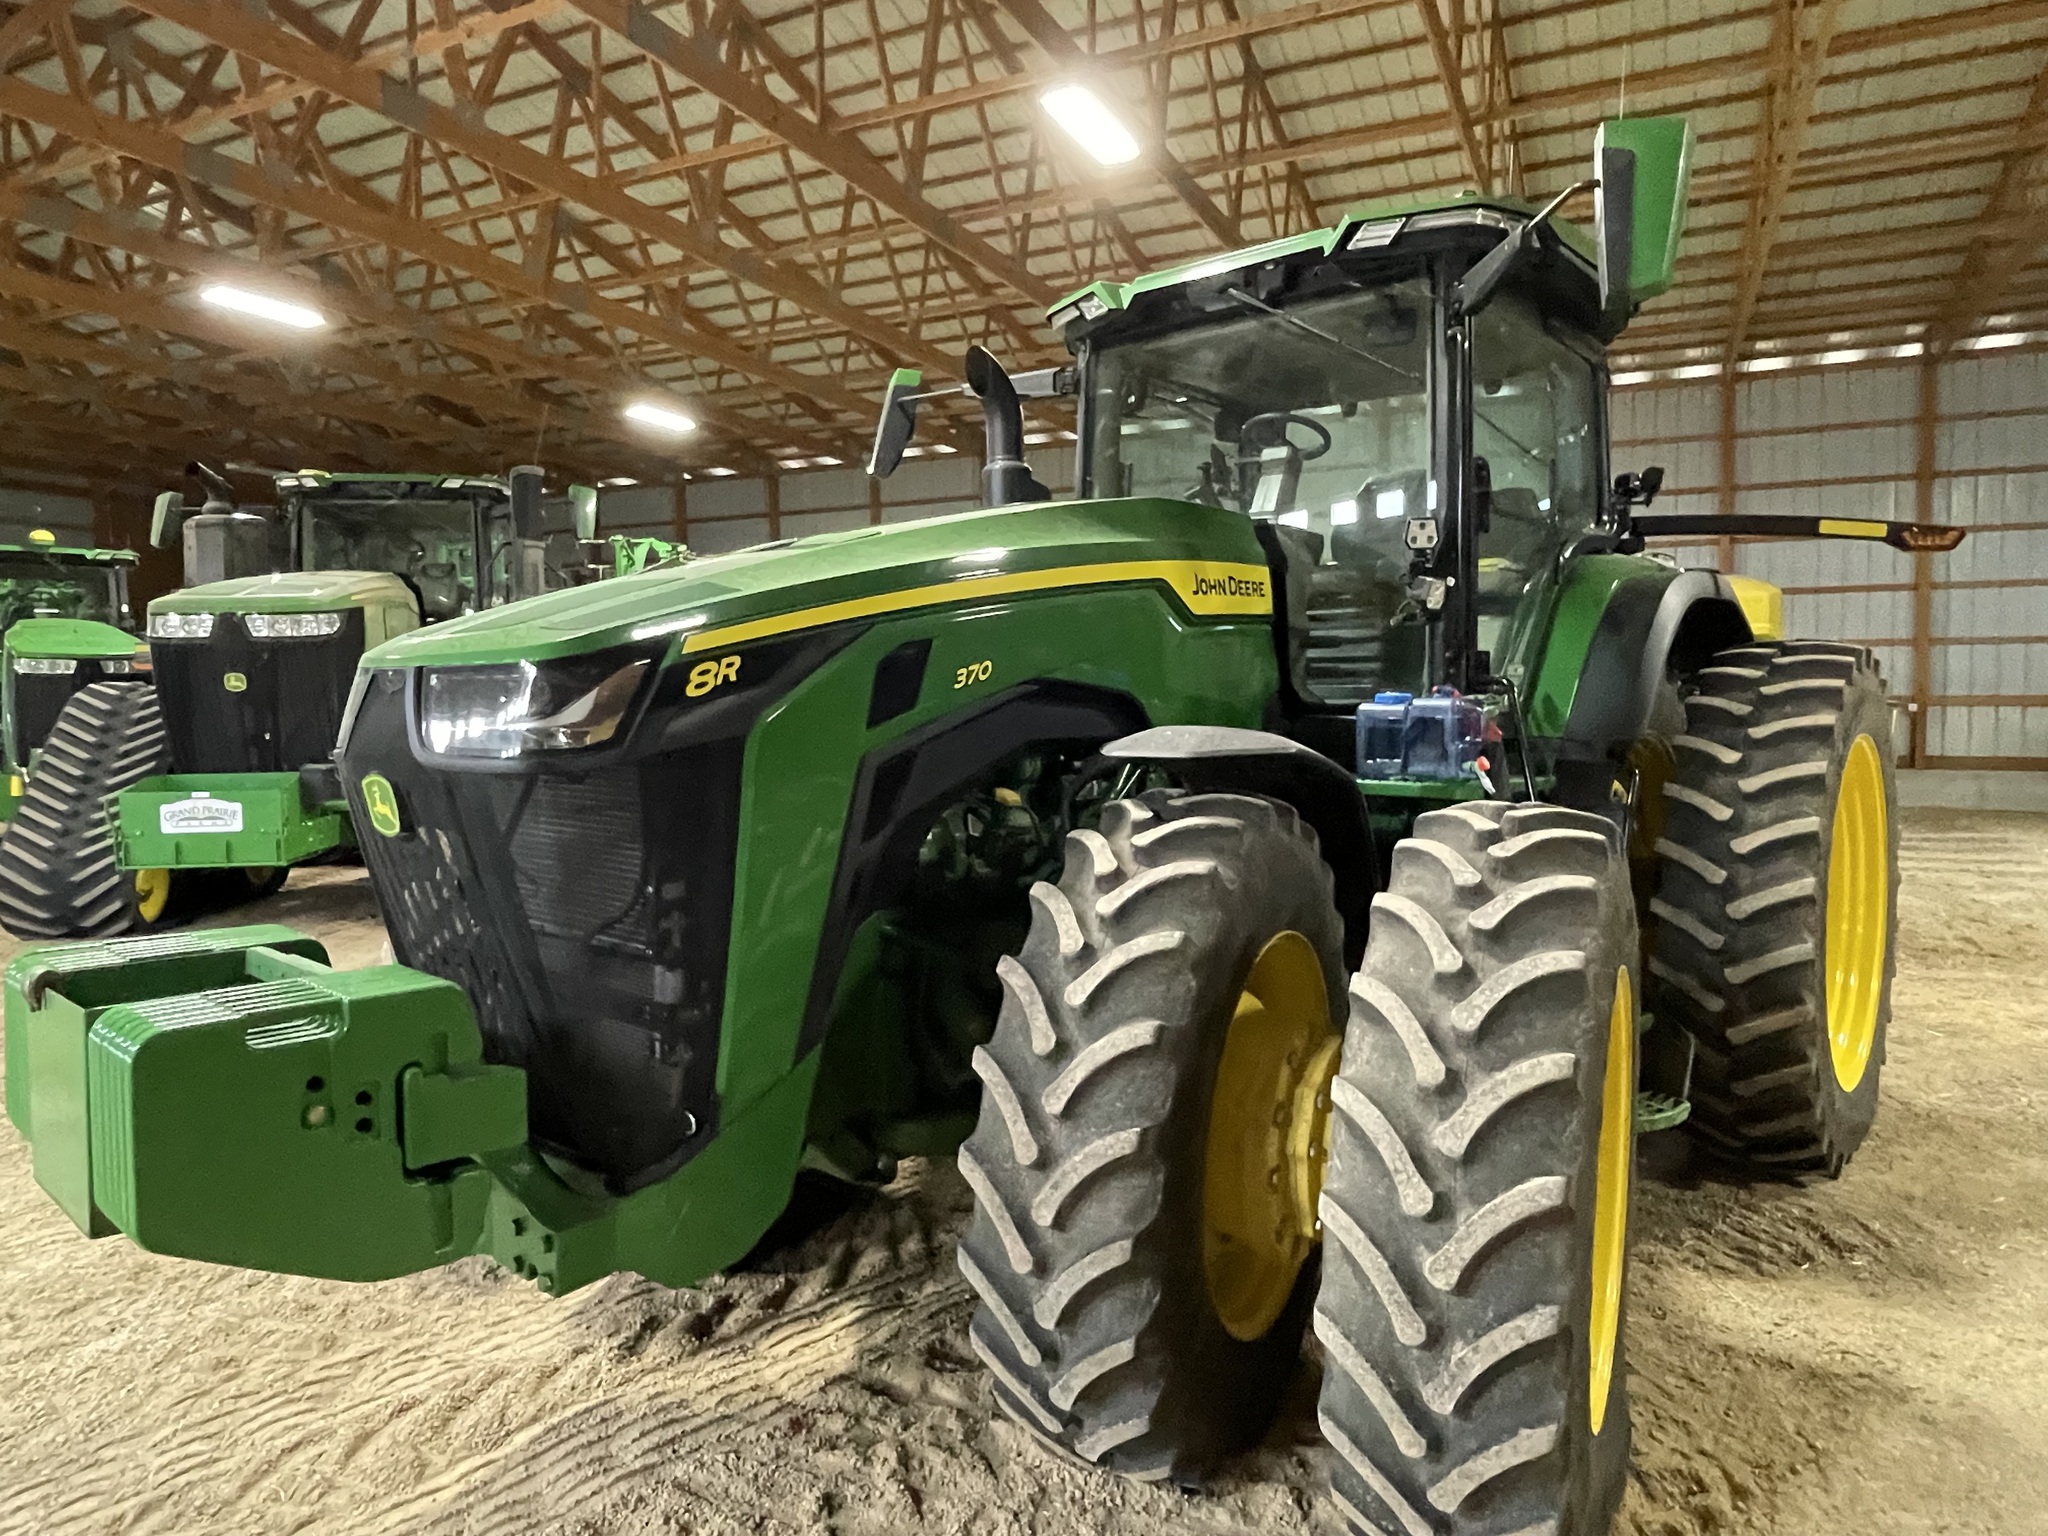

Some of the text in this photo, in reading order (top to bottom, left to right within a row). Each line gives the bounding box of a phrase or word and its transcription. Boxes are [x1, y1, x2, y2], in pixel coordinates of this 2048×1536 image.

[1192, 572, 1266, 598] JOHN DEERE
[685, 655, 741, 698] 8R
[953, 660, 993, 689] 370
[164, 805, 239, 822] GRAND PRAIRIE
